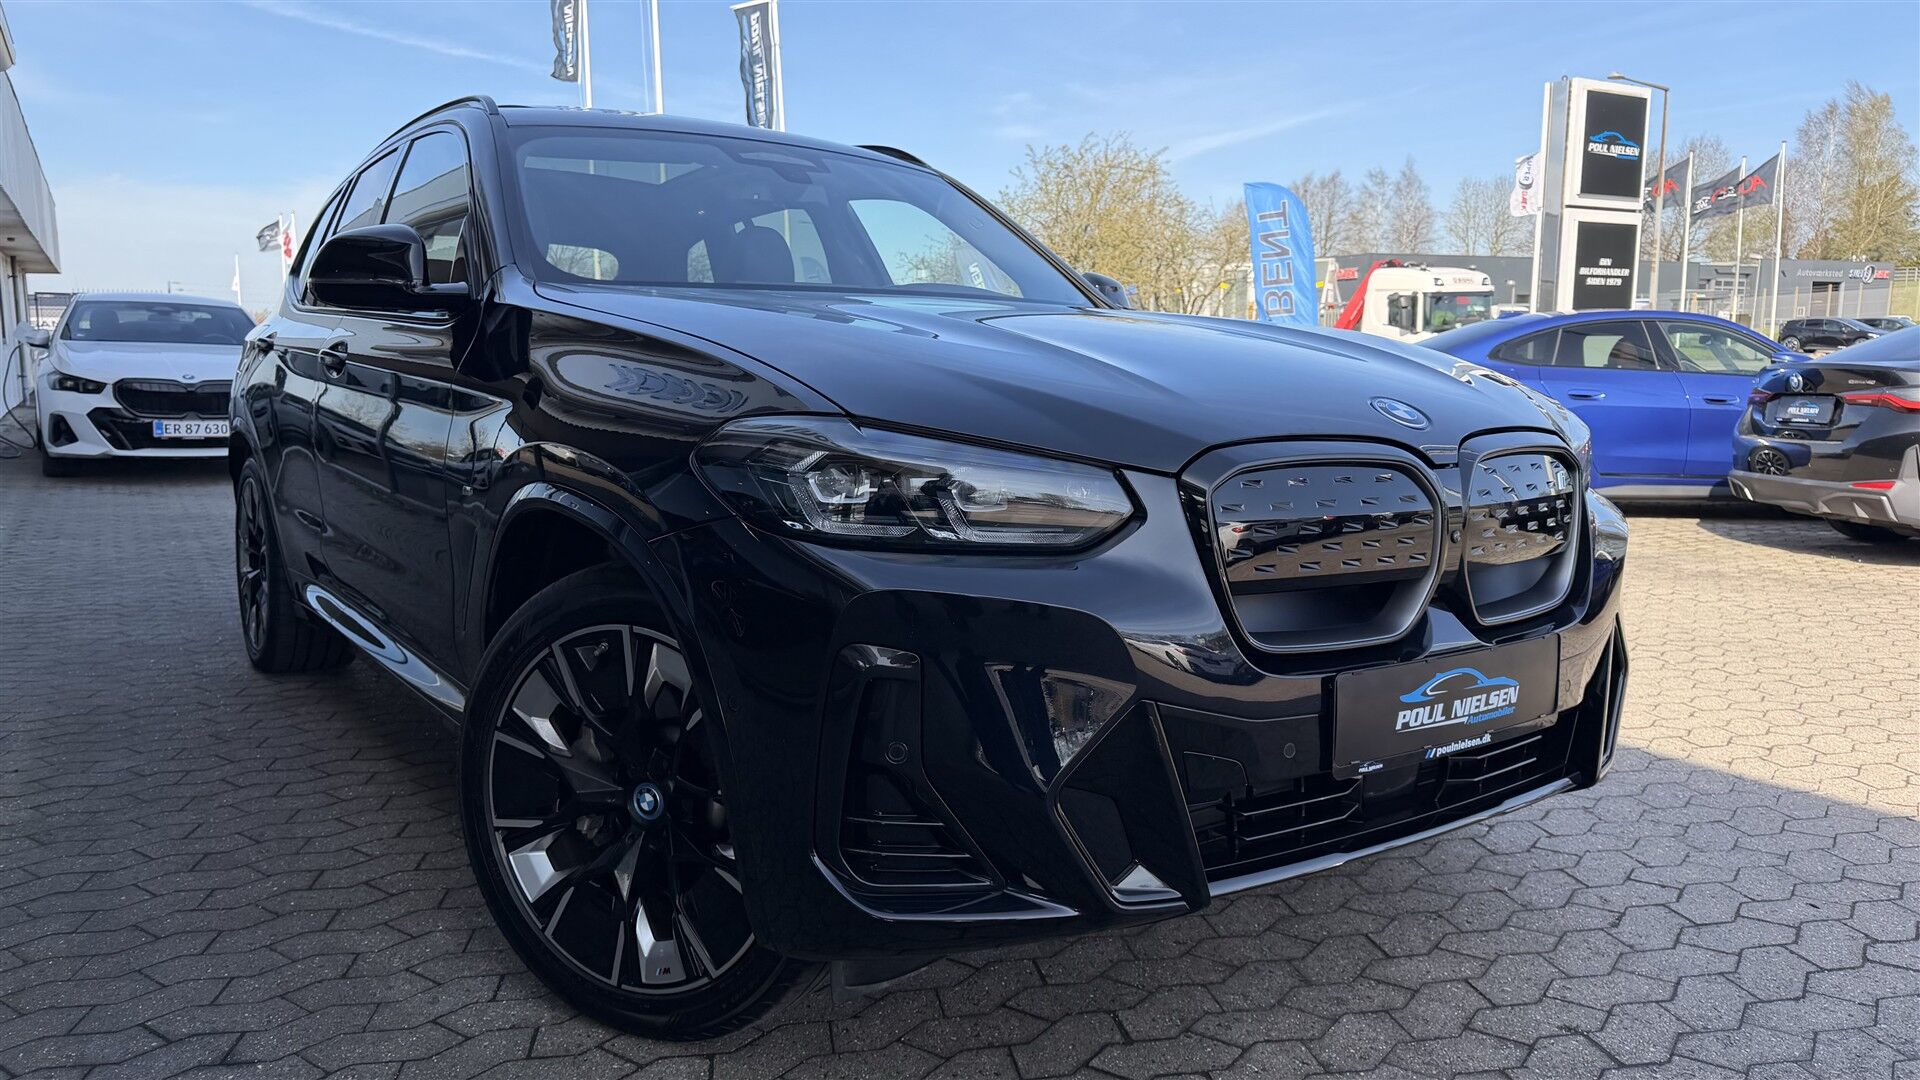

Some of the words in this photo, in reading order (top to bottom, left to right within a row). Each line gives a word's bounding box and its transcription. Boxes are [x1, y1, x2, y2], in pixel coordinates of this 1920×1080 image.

[1588, 142, 1608, 153] POUL
[1610, 145, 1640, 157] NIELSEN
[164, 424, 182, 434] ER
[185, 424, 201, 434] 87
[204, 424, 228, 434] 630
[1395, 703, 1446, 730] POUL
[1451, 686, 1520, 719] NIELSEN
[1467, 706, 1516, 725] Automobiler
